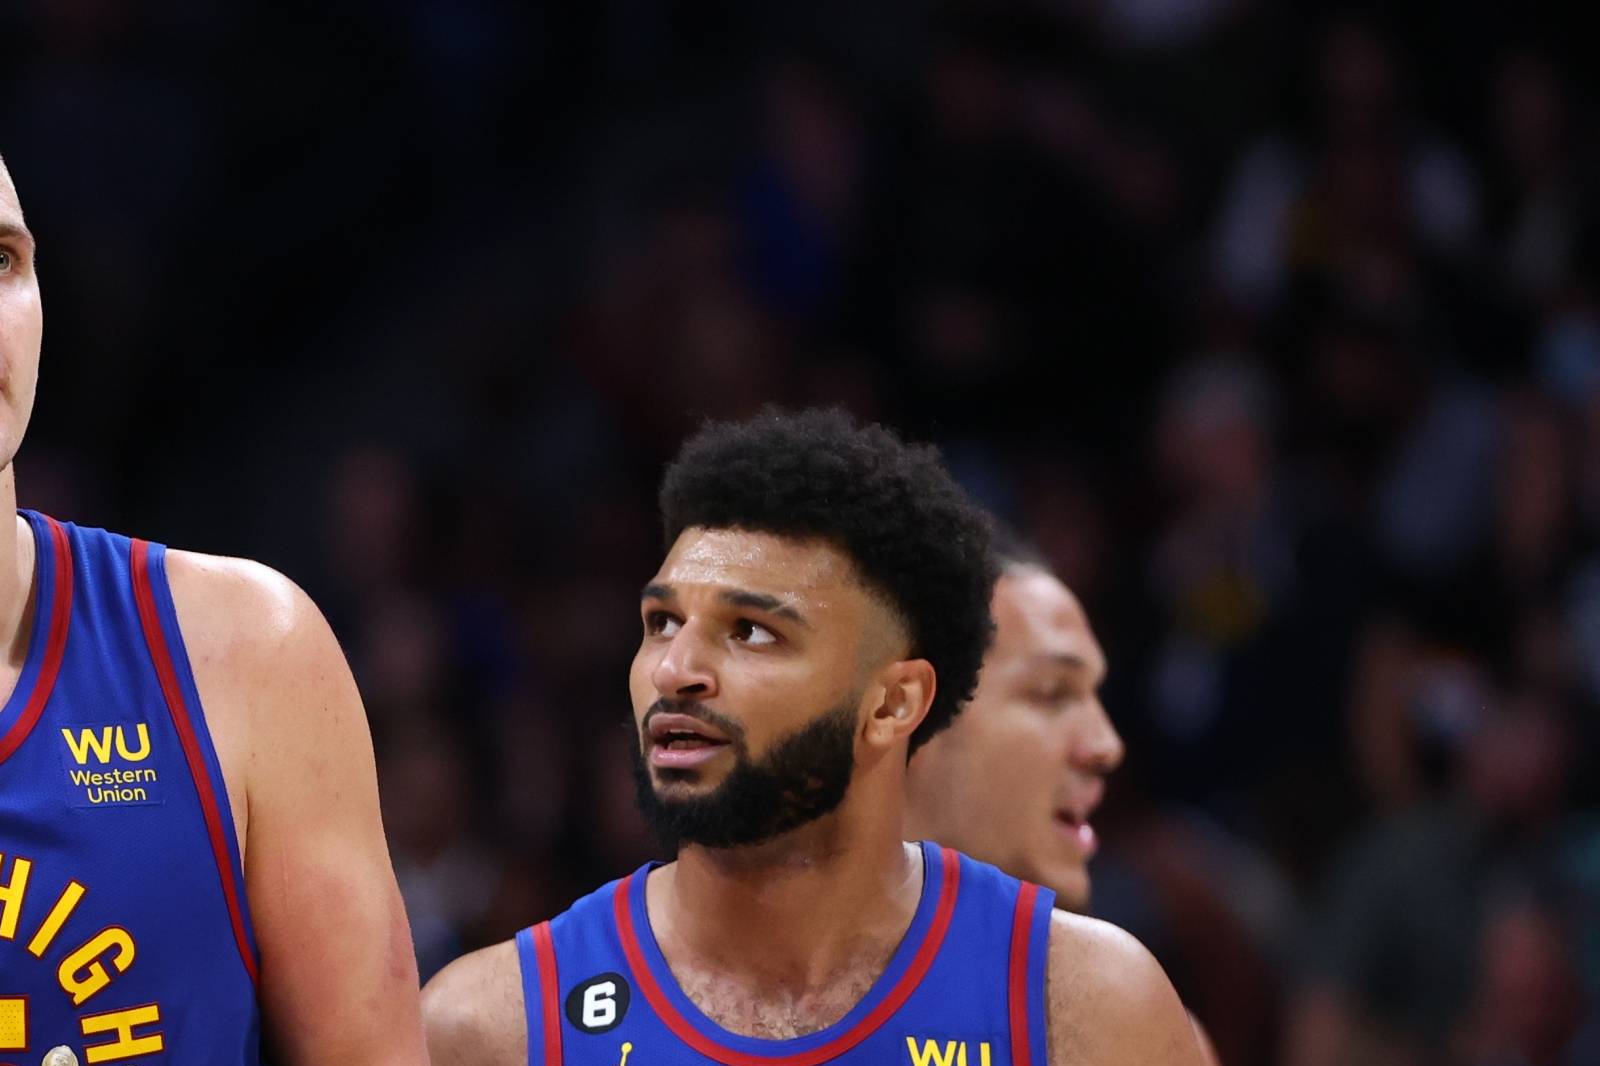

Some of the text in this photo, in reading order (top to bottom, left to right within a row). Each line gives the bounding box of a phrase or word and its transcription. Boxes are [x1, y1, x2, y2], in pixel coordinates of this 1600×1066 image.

[61, 723, 151, 765] WU
[69, 768, 157, 786] Western
[86, 784, 147, 804] Union
[581, 980, 618, 1028] 6
